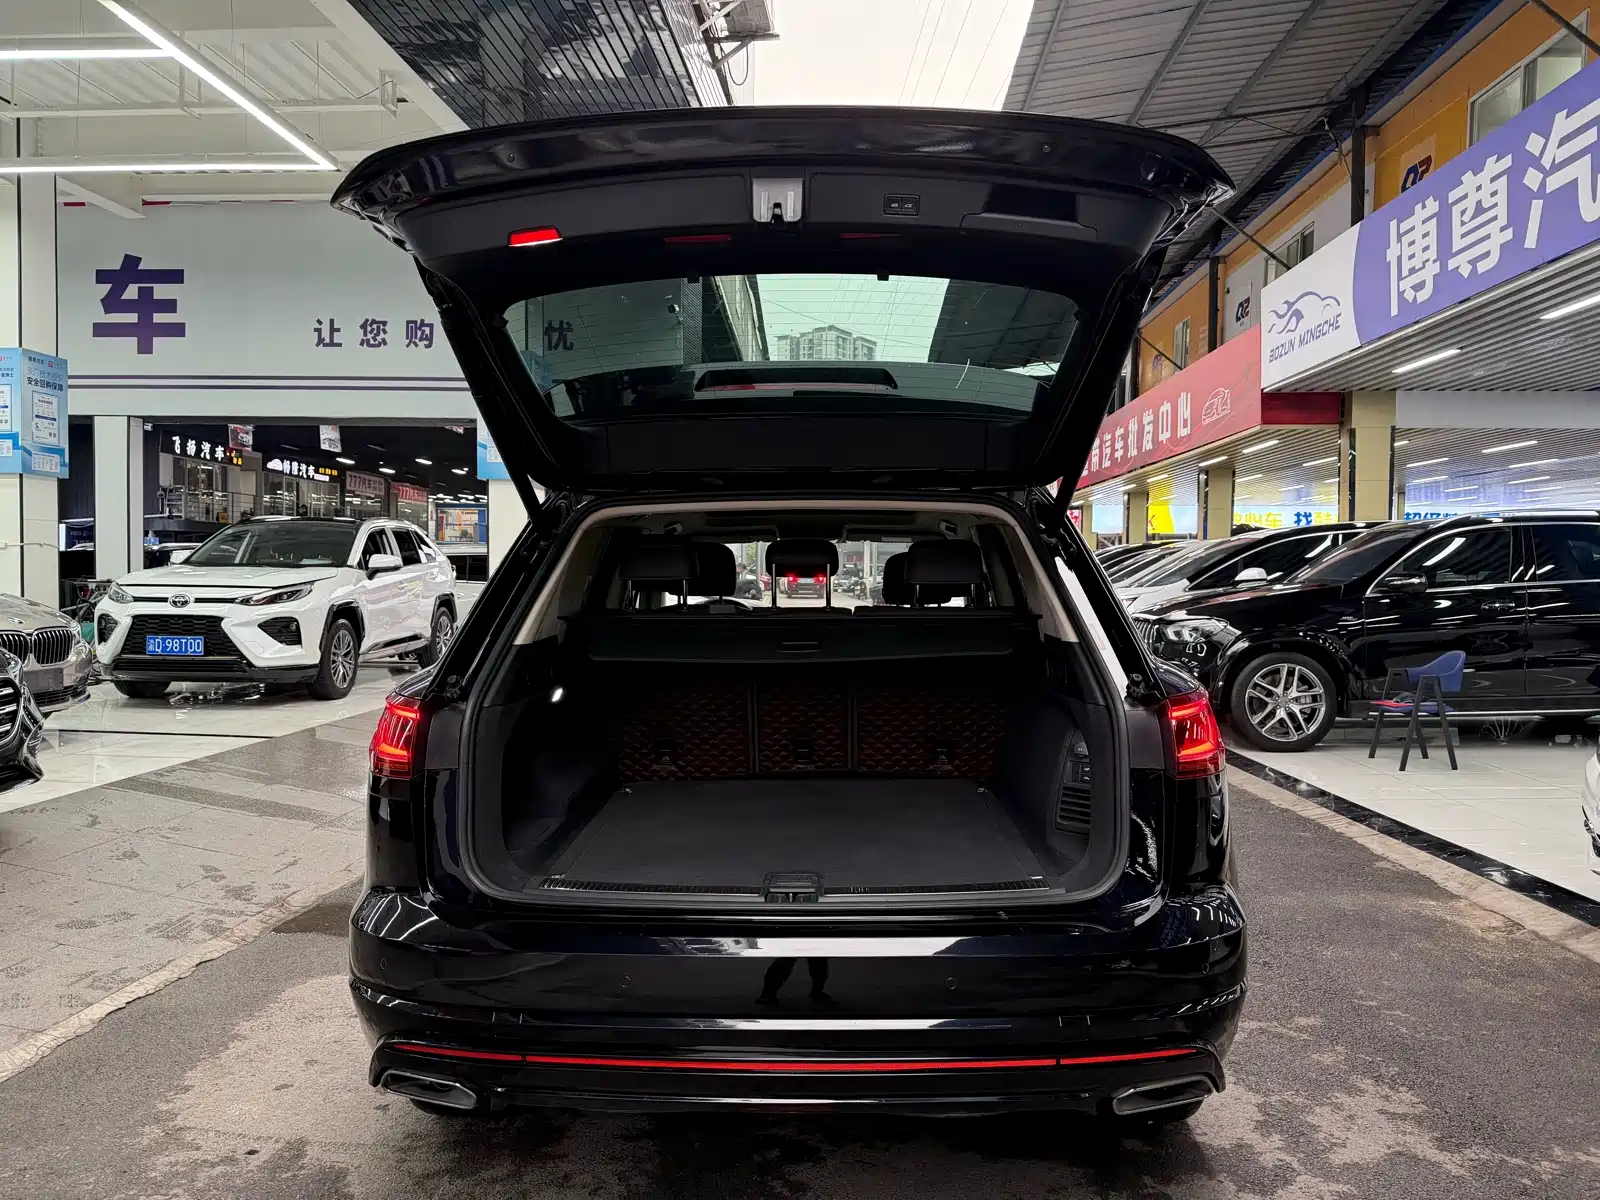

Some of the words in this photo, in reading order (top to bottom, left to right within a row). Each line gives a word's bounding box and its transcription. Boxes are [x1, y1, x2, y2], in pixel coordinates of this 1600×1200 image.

[1386, 98, 1600, 317] 博尊汽
[92, 253, 186, 354] 车
[313, 318, 434, 349] 让您购
[543, 319, 574, 351] 忧
[1268, 337, 1296, 364] BOZUN
[1298, 312, 1342, 349] MINGCHE
